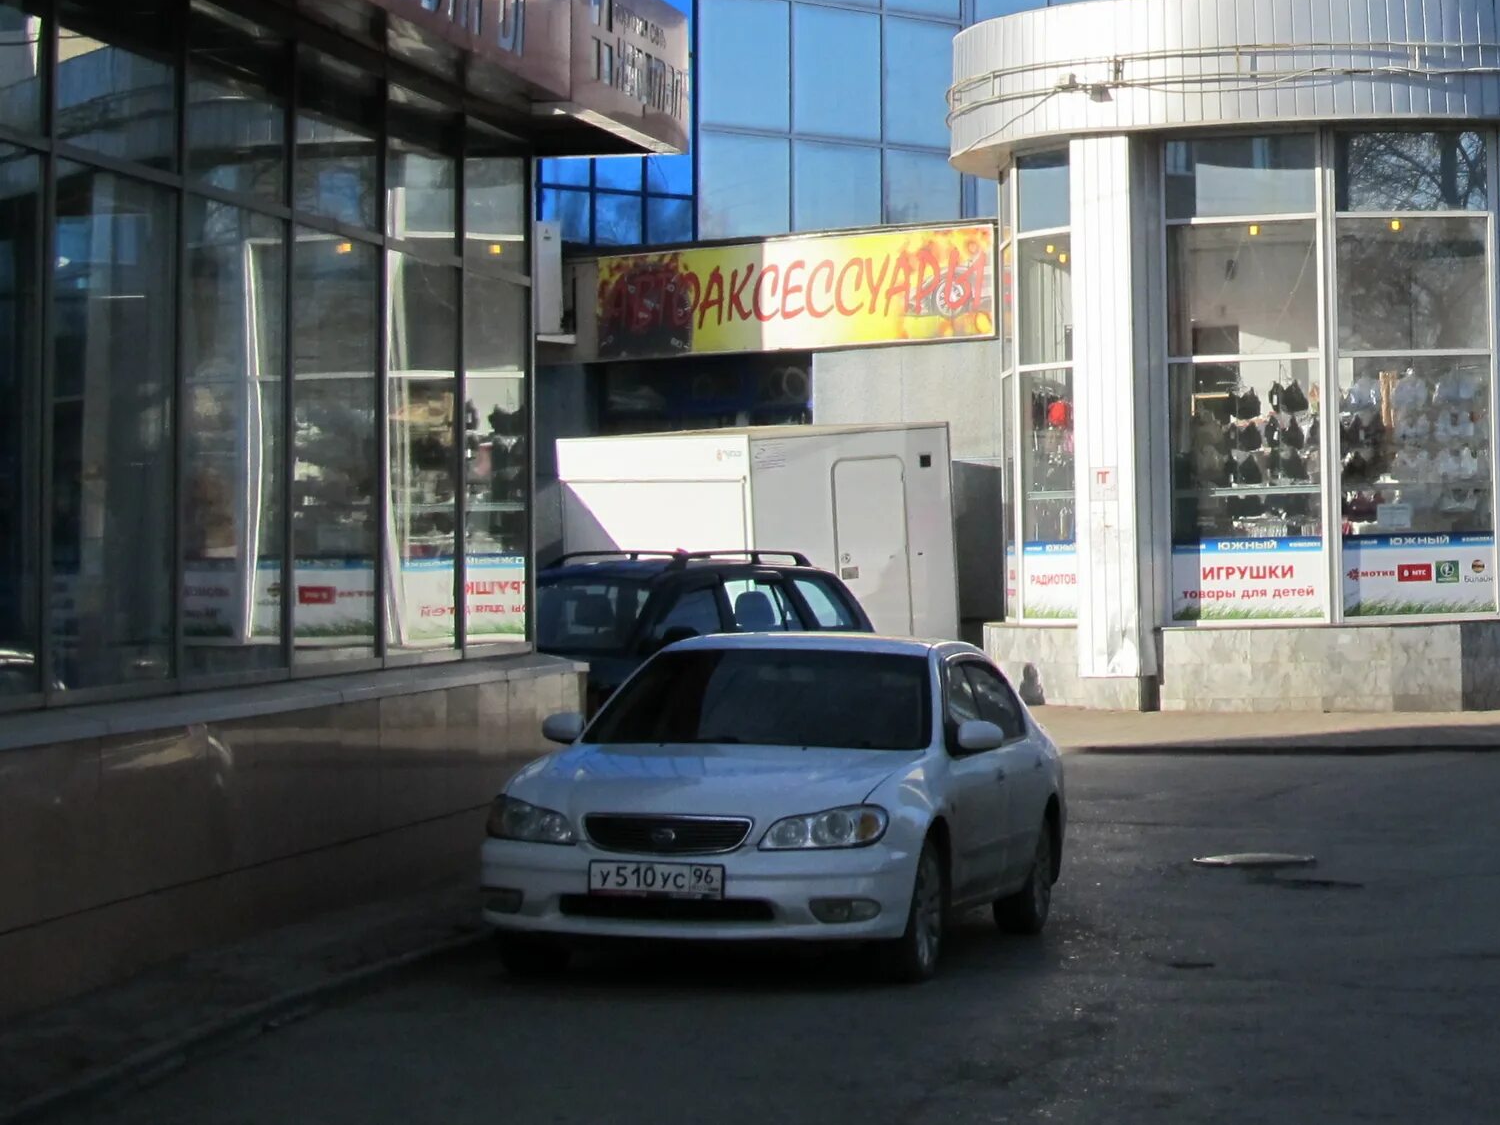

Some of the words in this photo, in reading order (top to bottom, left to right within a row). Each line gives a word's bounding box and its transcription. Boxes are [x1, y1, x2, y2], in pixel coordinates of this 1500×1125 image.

[1218, 539, 1277, 551] ЮЖНЫЙ
[1389, 534, 1450, 545] ЮЖНЫЙ
[1202, 565, 1294, 581] ИГРУШКИ
[1182, 588, 1236, 600] товары
[1241, 587, 1267, 600] для
[1273, 585, 1315, 598] детей
[693, 868, 714, 885] 96
